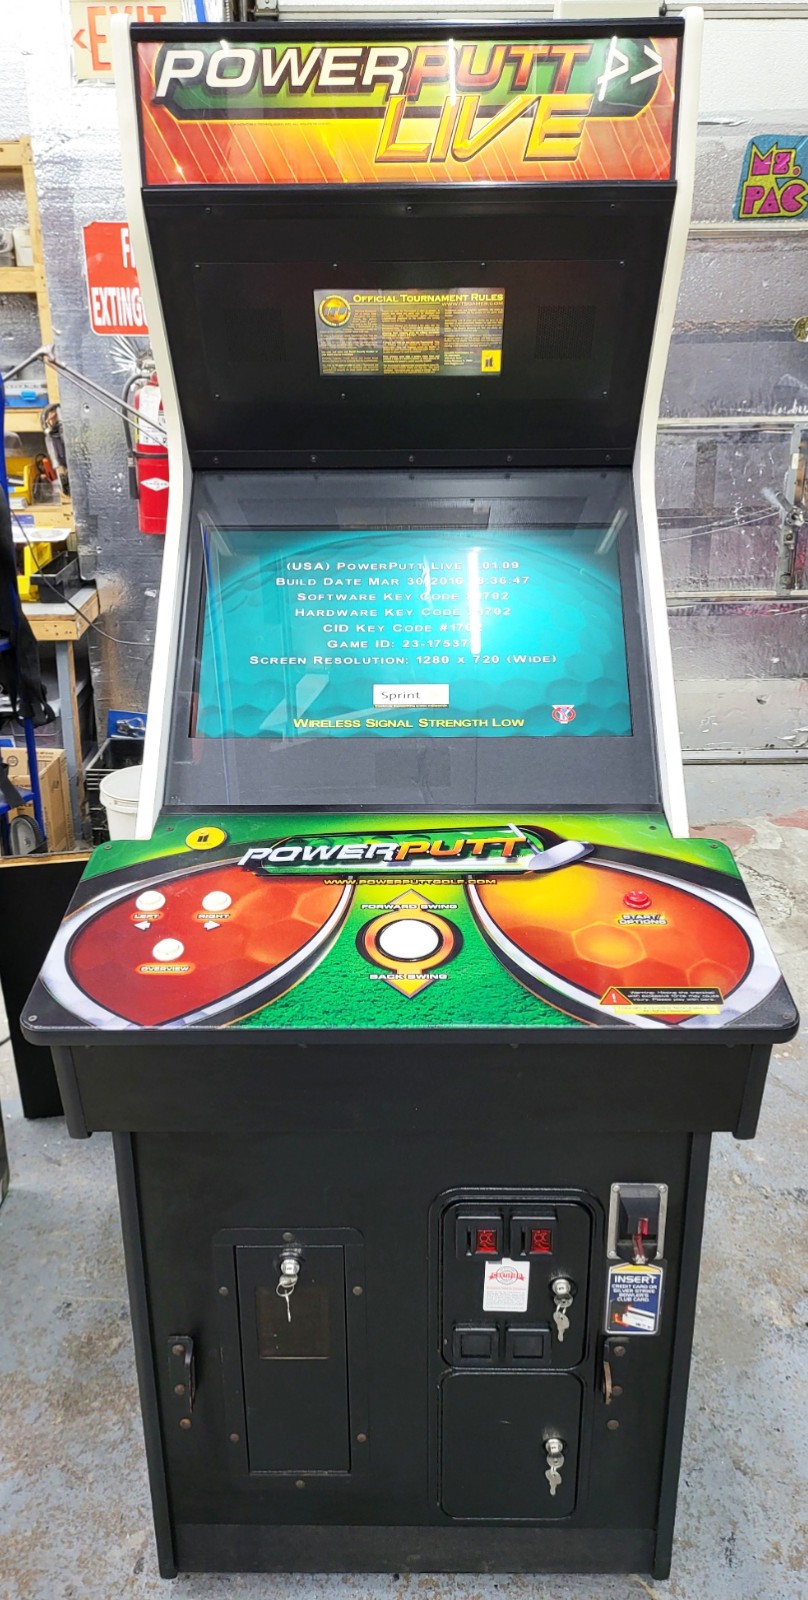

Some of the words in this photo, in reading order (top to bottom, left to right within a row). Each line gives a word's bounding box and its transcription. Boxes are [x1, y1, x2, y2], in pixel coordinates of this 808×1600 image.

[375, 95, 594, 164] LIVE
[741, 184, 807, 215] PAC
[353, 294, 399, 303] OFFICIAL
[400, 294, 469, 302] TOURNAMENT
[471, 293, 504, 301] RULES
[91, 287, 148, 327] EXTING
[287, 562, 330, 571] (USA)
[431, 562, 462, 570] LIVE
[276, 577, 317, 586] BUILD
[323, 577, 361, 586] DATE
[368, 577, 399, 585] MAR
[431, 577, 463, 585] 2016
[297, 593, 377, 601] SOFTWARE
[383, 593, 412, 601] KEY
[295, 608, 378, 617] HARDWARE
[384, 608, 413, 616] KEY
[322, 624, 349, 633] CID
[356, 624, 385, 633] KEY
[392, 624, 432, 632] CODE
[327, 640, 368, 648] GAME
[375, 640, 395, 648] ID:
[250, 656, 307, 665] SCREEN
[313, 656, 409, 665] RESOLUTION:
[417, 656, 450, 664] 1280
[472, 655, 500, 664] 720
[506, 655, 557, 664] (WIDE)
[381, 691, 421, 701] Sprint
[293, 718, 361, 728] WIRELESS
[366, 718, 414, 728] SIGNAL
[418, 718, 489, 728] STRENGTH
[492, 718, 525, 727] LOW
[614, 1275, 657, 1284] INSERT
